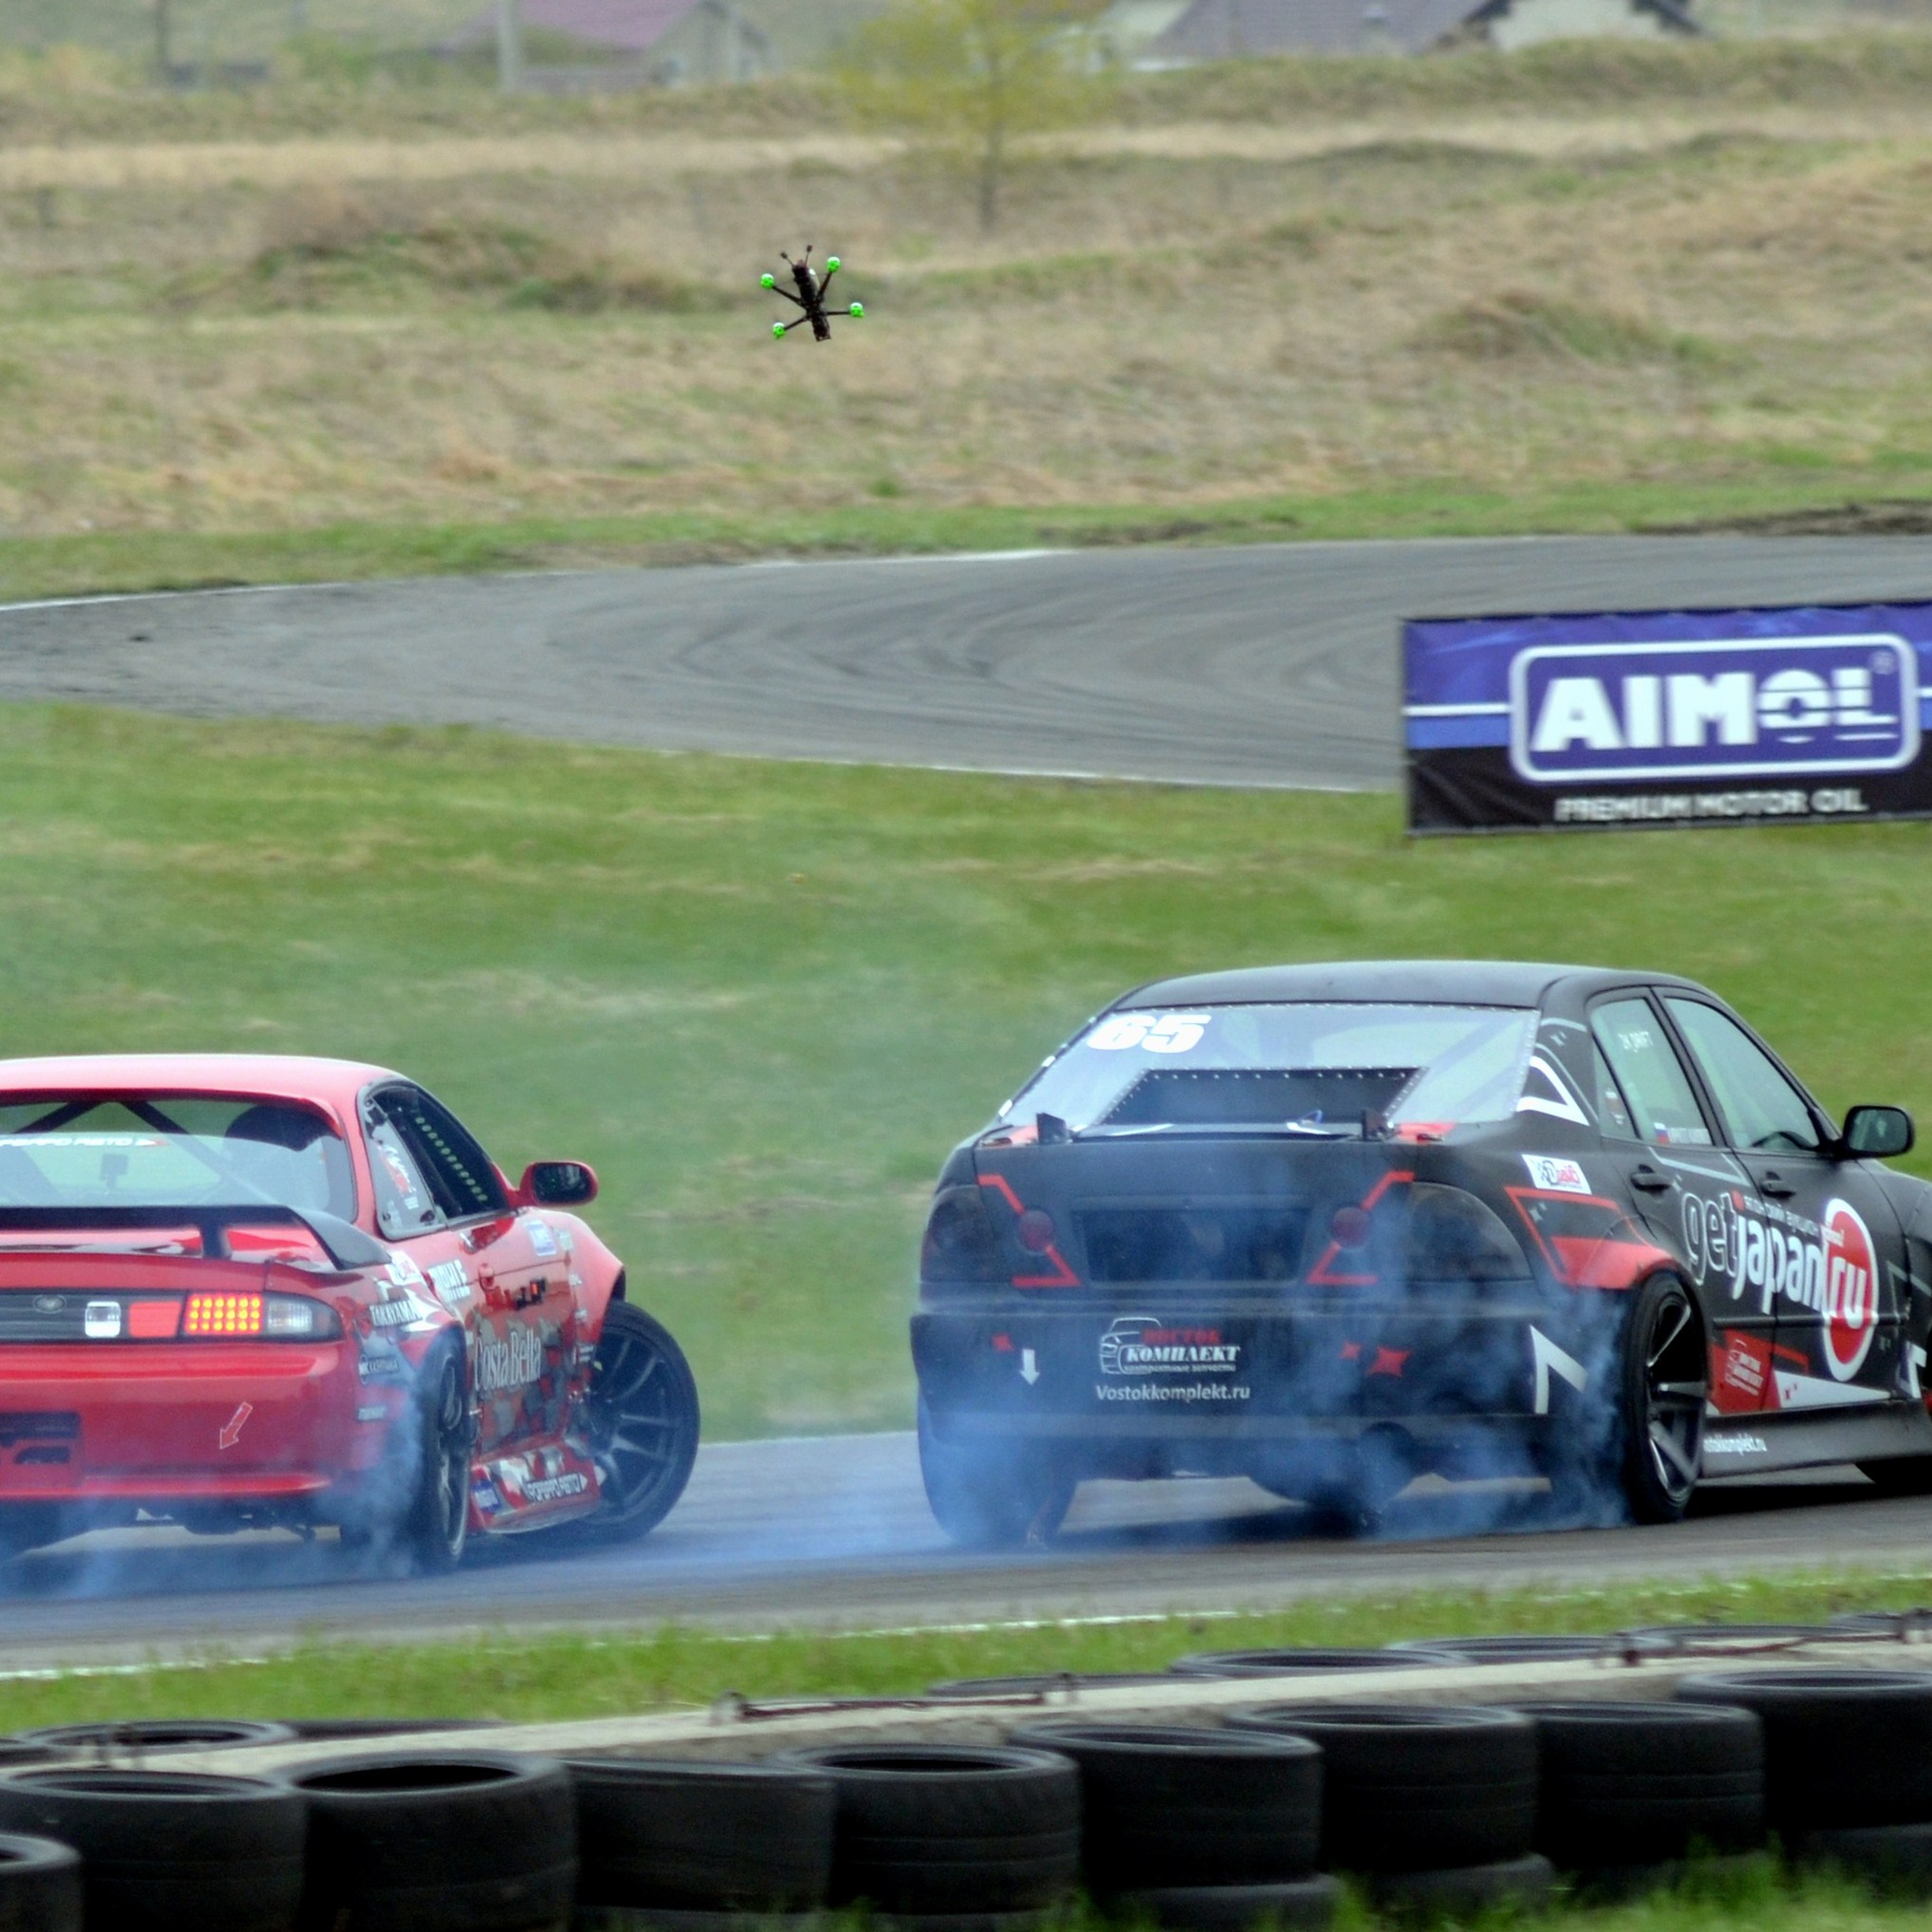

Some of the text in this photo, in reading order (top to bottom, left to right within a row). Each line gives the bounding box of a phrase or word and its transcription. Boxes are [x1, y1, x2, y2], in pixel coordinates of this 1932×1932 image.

[1530, 667, 1898, 752] AIMOL
[1554, 788, 1869, 821] PREMIUM MOTOR OIL
[1085, 1014, 1211, 1053] 65
[1097, 1383, 1251, 1404] Vostokkomplekt.ru
